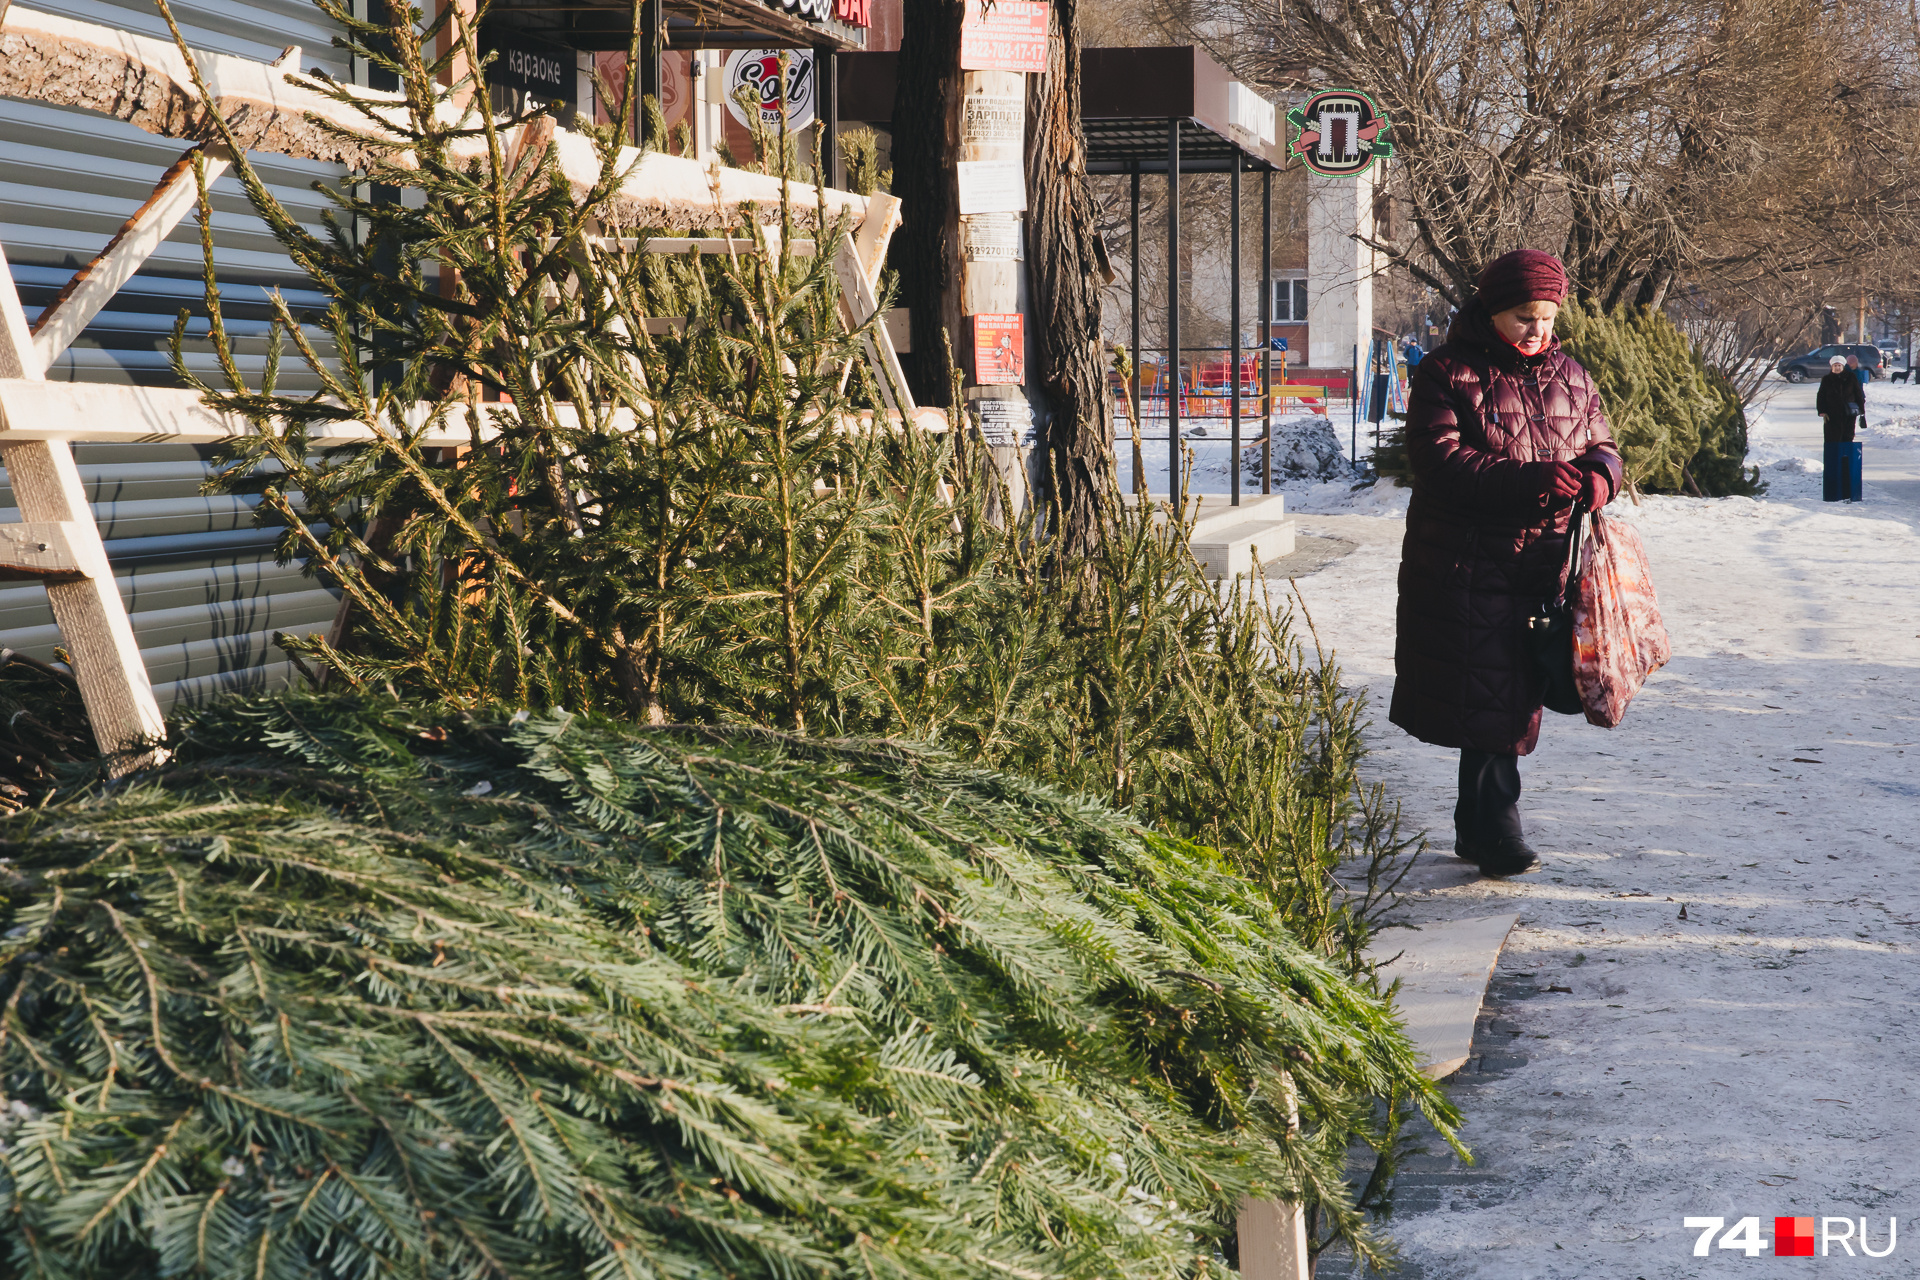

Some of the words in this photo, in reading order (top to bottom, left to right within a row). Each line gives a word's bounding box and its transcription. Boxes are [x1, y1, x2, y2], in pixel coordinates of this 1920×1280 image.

[963, 31, 1045, 42] НАРКОЗАВИСИМЫМ
[963, 40, 1045, 60] 8-922-702-17-17
[509, 49, 560, 84] караоке
[967, 110, 1022, 120] ЗАРПЛАТА
[978, 314, 1004, 322] РАБОЧИЙ
